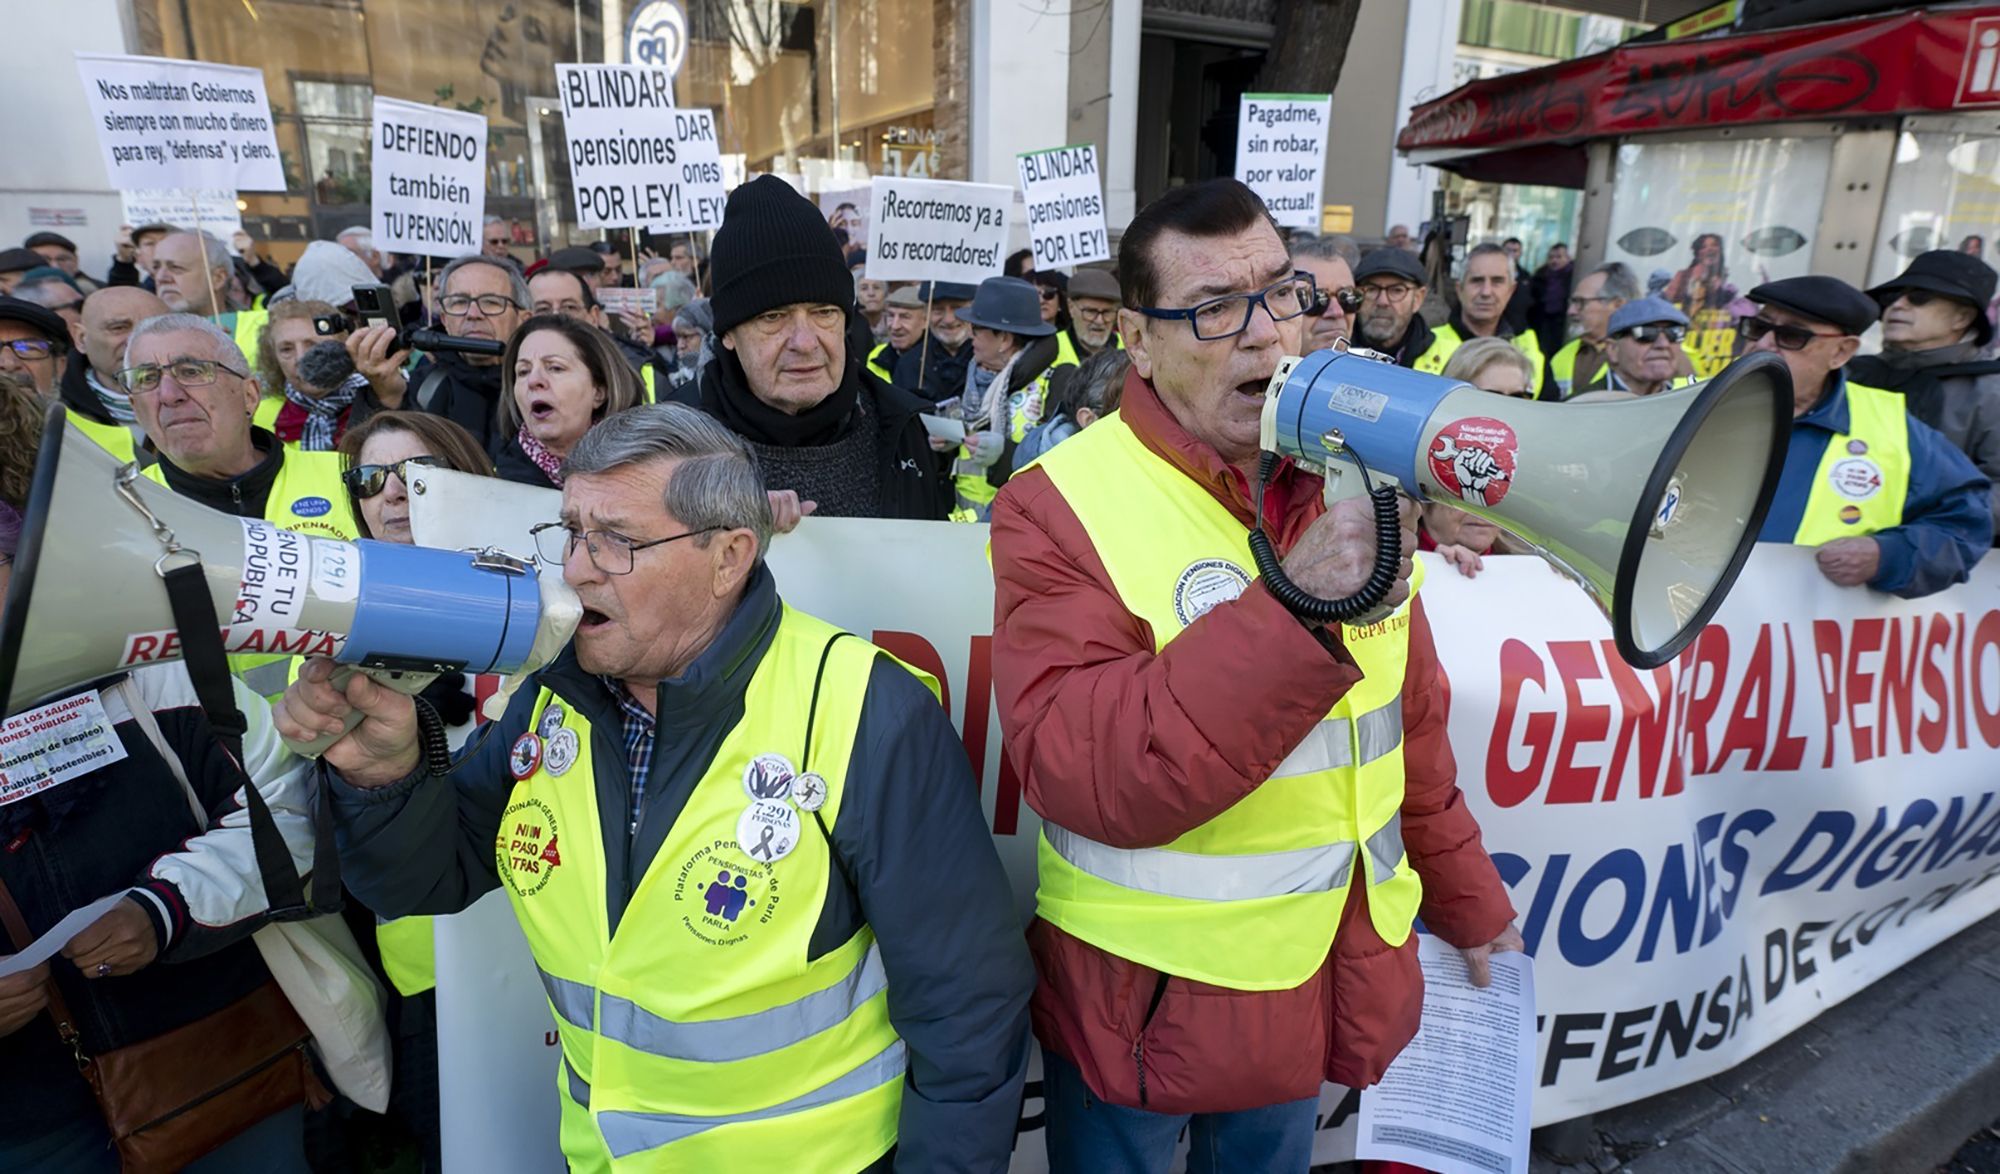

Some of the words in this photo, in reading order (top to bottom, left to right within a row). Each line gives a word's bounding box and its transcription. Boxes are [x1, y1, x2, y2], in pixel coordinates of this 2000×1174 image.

[96, 79, 128, 100] Nos
[130, 81, 190, 101] maltratan
[191, 82, 256, 104] Gobiernos
[562, 70, 670, 118] ¡BLINDAR
[104, 111, 157, 135] siempre
[159, 116, 181, 131] con
[183, 112, 228, 131] mucho
[230, 112, 268, 131] dinero
[1248, 103, 1321, 128] Pagadme,
[382, 122, 477, 162] DEFIENDO
[887, 126, 946, 146] PEINAR
[1247, 134, 1268, 153] sin
[1273, 134, 1319, 155] robar,
[111, 144, 144, 166] para
[166, 140, 227, 160] "defensa"
[230, 146, 239, 164] y
[242, 141, 276, 160] clero.
[571, 128, 676, 177] pensiones
[1020, 148, 1095, 190] ¡BLINDAR
[1246, 169, 1273, 185] por
[1276, 163, 1317, 181] valor
[389, 172, 470, 205] también
[578, 185, 628, 222] POR
[632, 183, 682, 219] LEY!
[1266, 192, 1315, 211] actual!
[881, 189, 972, 224] ¡Recortemos
[974, 207, 991, 232] ya
[995, 212, 1003, 227] a
[1029, 193, 1100, 232] pensiones
[383, 211, 404, 239] TU
[407, 211, 476, 246] PENSIÓN.
[878, 233, 897, 260] los
[902, 237, 999, 268] recortadores!
[1034, 235, 1066, 265] POR
[1070, 228, 1107, 259] LEY!
[233, 543, 272, 625] PÚBLICA
[1182, 562, 1224, 582] PENSIONES
[271, 587, 296, 616] TU
[1349, 621, 1386, 642] CGPM
[8, 719, 22, 730] DE
[24, 712, 43, 724] LOS
[45, 695, 95, 718] SALARIOS,
[1485, 621, 1807, 808] GENERAL
[47, 741, 61, 752] de
[62, 725, 104, 747] Empleo)
[2, 772, 48, 794] Publicas
[49, 748, 107, 776] Sostenibles
[752, 814, 791, 829] PERSONAS
[754, 802, 792, 822] 7.291
[515, 823, 529, 837] NI
[510, 840, 538, 856] PASO
[674, 844, 712, 901] Plataforma
[707, 855, 764, 879] PENSIONISTAS
[769, 878, 779, 893] de
[702, 915, 731, 932] PARLA
[759, 895, 780, 925] Parla
[682, 915, 717, 946] Pensiones
[718, 934, 749, 946] Dignas
[1764, 919, 1835, 1005] DE
